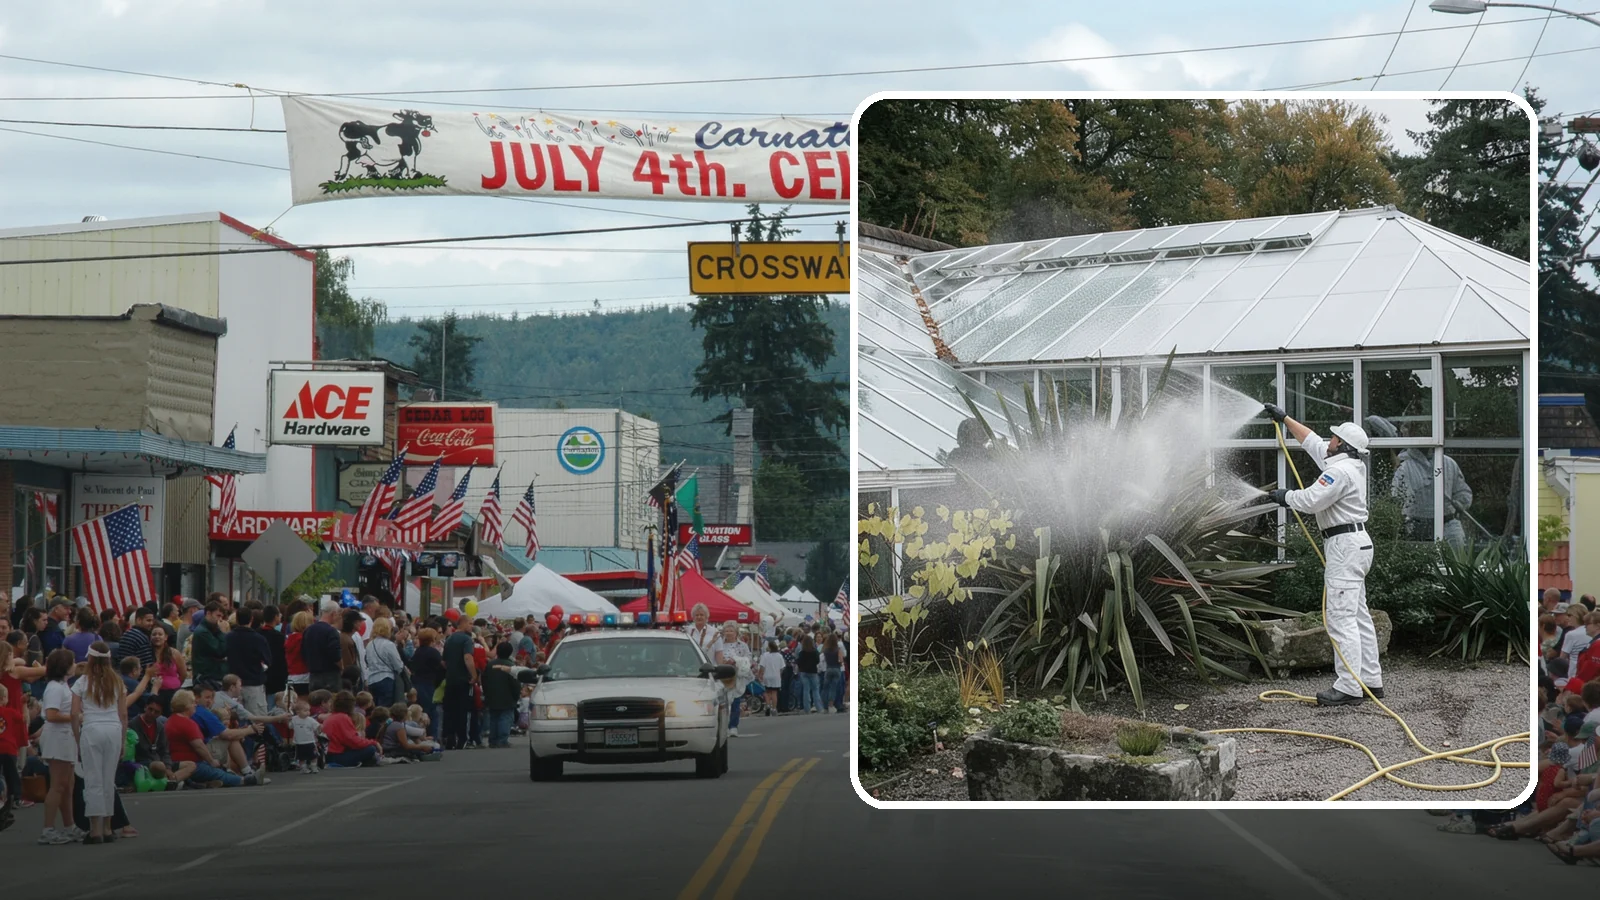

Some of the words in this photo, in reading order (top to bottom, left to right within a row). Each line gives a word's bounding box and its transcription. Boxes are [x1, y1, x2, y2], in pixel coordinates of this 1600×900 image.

[481, 140, 605, 192] JULY
[632, 150, 747, 198] 4th.
[697, 254, 850, 280] CROSSWA
[282, 380, 373, 420] ACE
[405, 409, 453, 422] CEDAR
[283, 421, 371, 436] Hardware
[83, 484, 93, 494] St.
[95, 484, 124, 495] Vincent
[126, 486, 136, 495] de
[137, 486, 155, 495] Paul
[688, 526, 741, 535] CRNATION
[699, 535, 730, 543] GLASS
